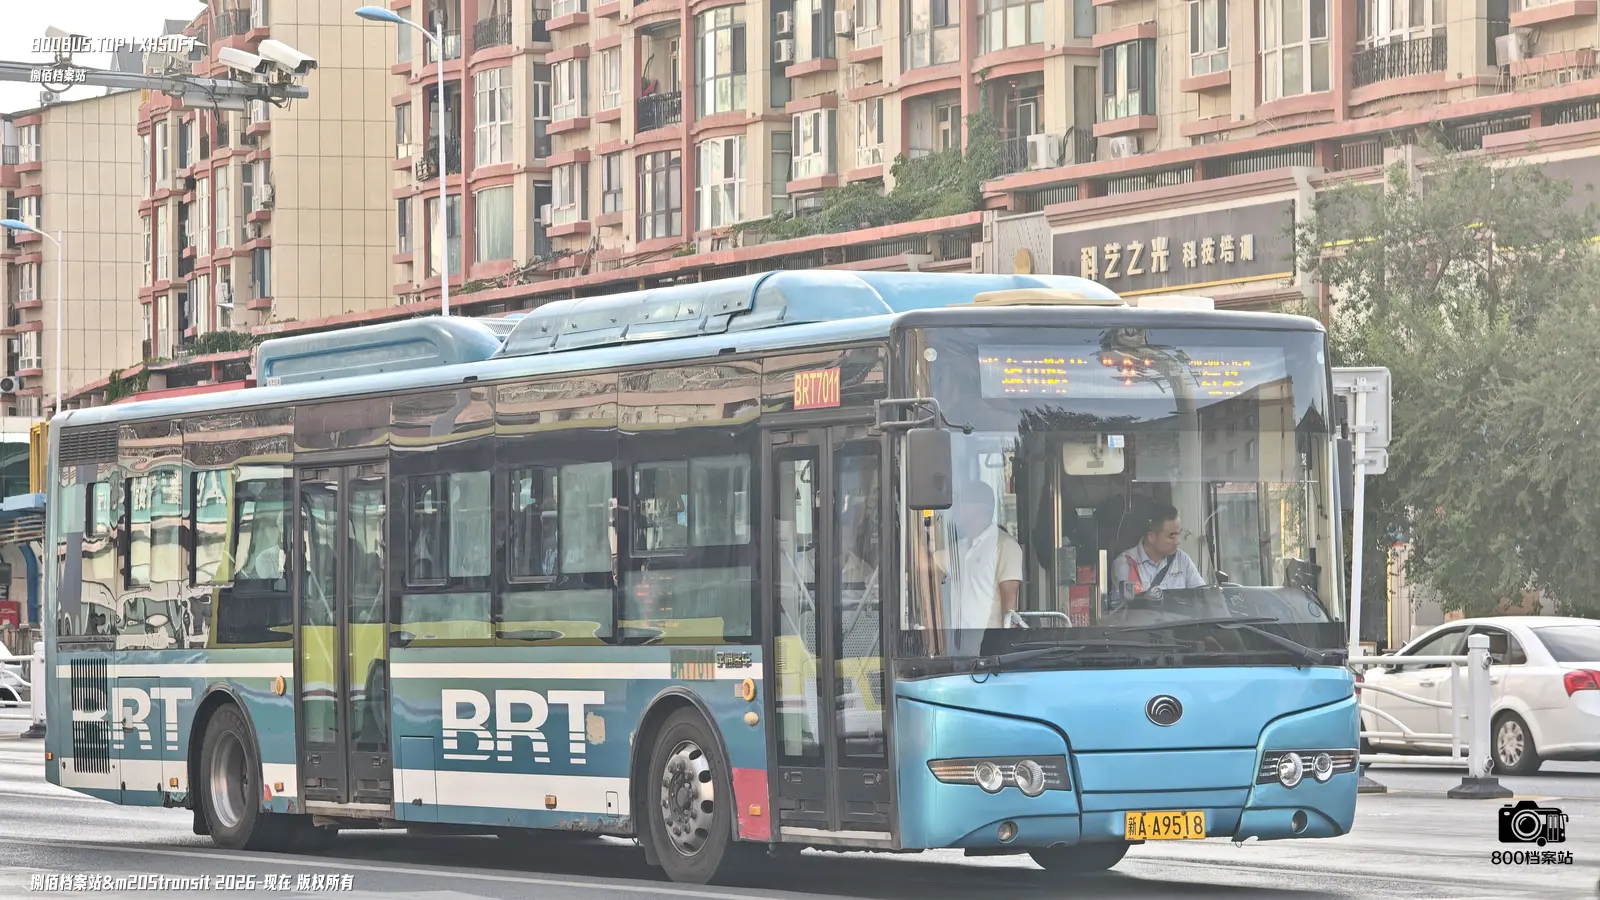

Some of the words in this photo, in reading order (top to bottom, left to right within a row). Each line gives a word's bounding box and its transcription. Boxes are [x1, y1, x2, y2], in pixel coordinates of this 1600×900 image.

[1080, 236, 1170, 281] 科艺之光
[1182, 233, 1255, 269] 科技培训
[794, 370, 840, 406] BRT7011
[73, 687, 192, 750] BRT
[442, 689, 605, 764] BRT
